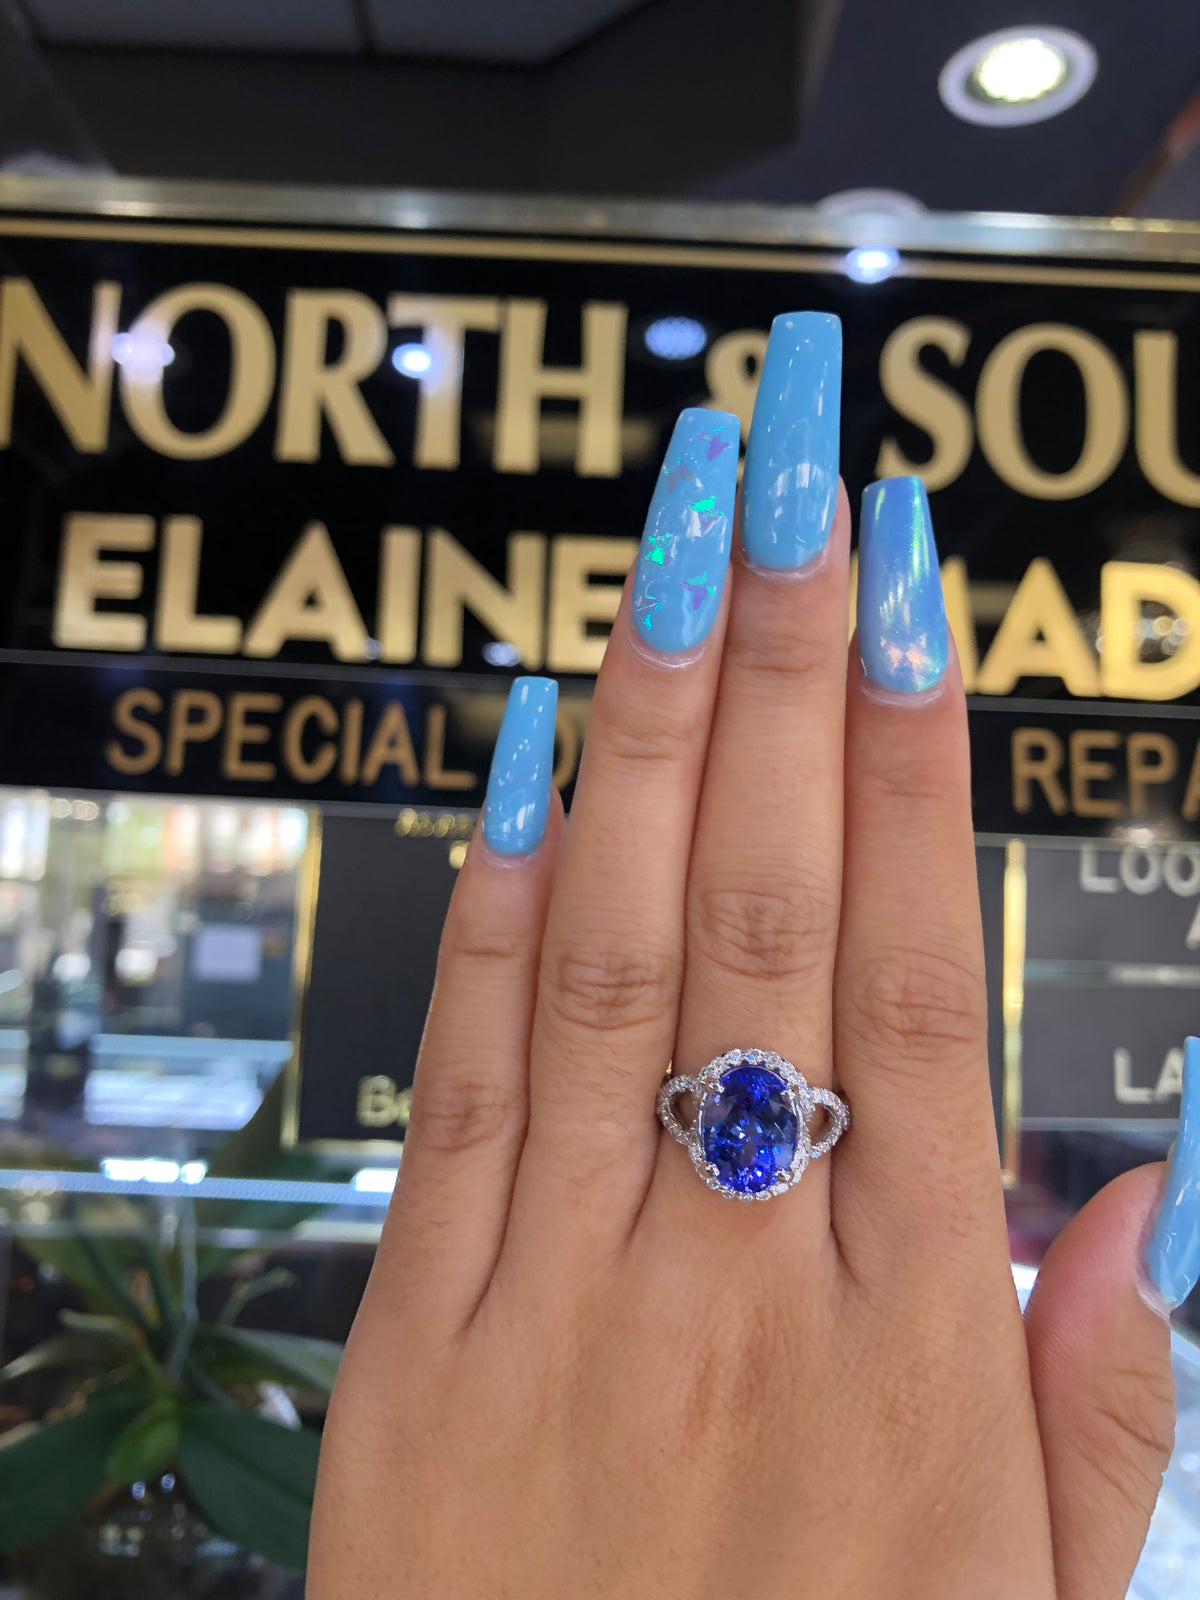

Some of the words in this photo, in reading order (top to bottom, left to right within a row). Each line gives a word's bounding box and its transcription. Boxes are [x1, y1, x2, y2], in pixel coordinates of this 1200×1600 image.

[0, 276, 629, 478] NORTH
[53, 511, 637, 674] ELAINE
[106, 688, 477, 791] SPECIAL
